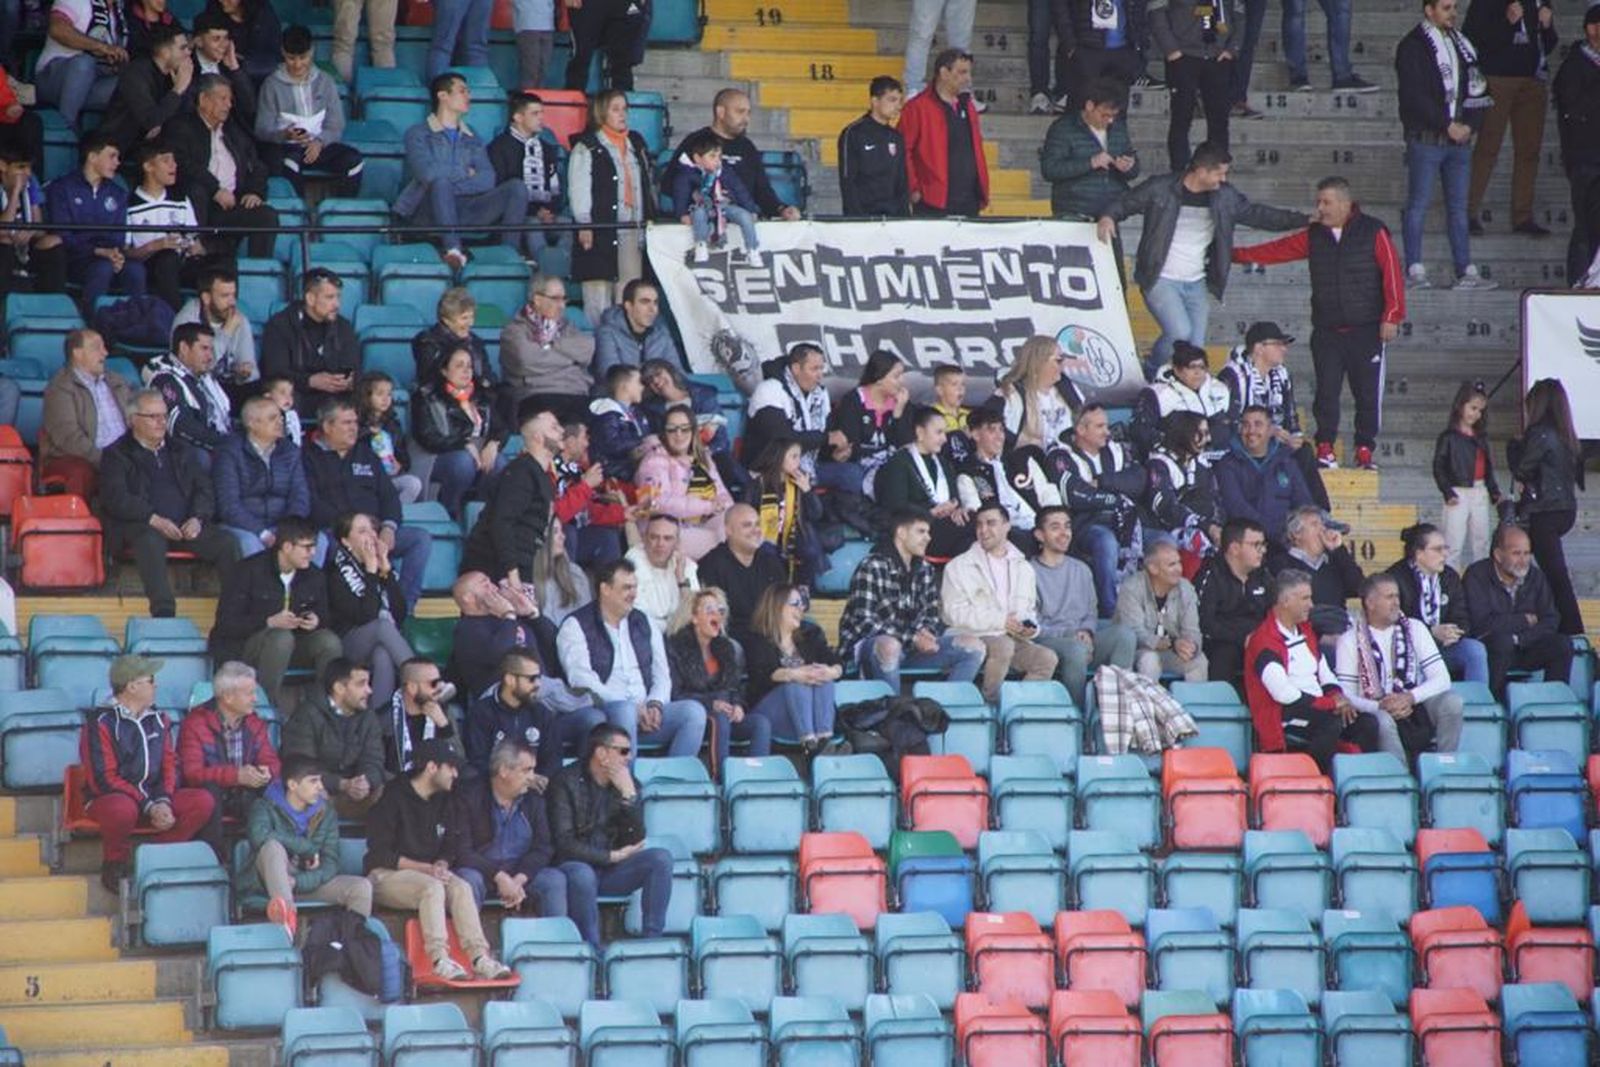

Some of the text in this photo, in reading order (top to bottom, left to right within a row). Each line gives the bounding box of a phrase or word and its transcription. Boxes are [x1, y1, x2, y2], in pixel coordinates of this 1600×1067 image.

[755, 8, 782, 27] 19
[809, 63, 835, 81] 18
[1266, 94, 1287, 107] 18
[692, 252, 1098, 304] SENTIMIENTO
[1467, 323, 1491, 336] 20
[25, 976, 40, 998] 5
